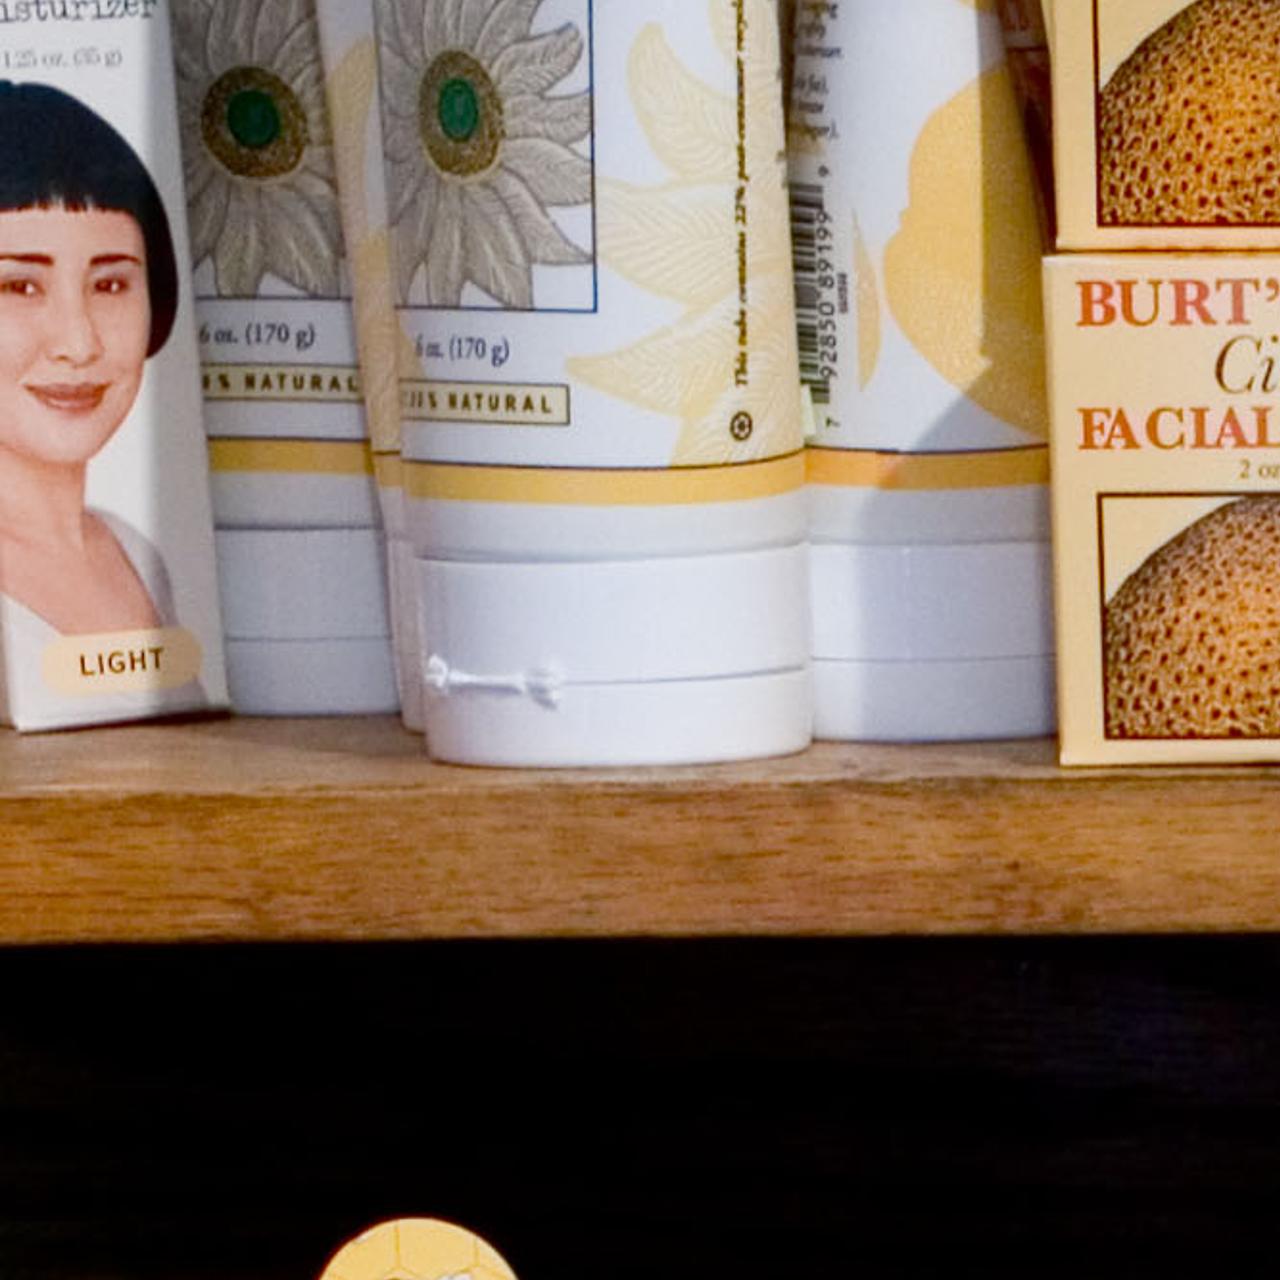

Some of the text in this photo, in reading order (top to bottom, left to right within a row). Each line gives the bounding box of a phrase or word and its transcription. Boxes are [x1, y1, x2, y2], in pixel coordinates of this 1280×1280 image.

[449, 394, 552, 413] NATURAL
[1240, 460, 1251, 479] 2
[80, 648, 165, 676] LIGHT
